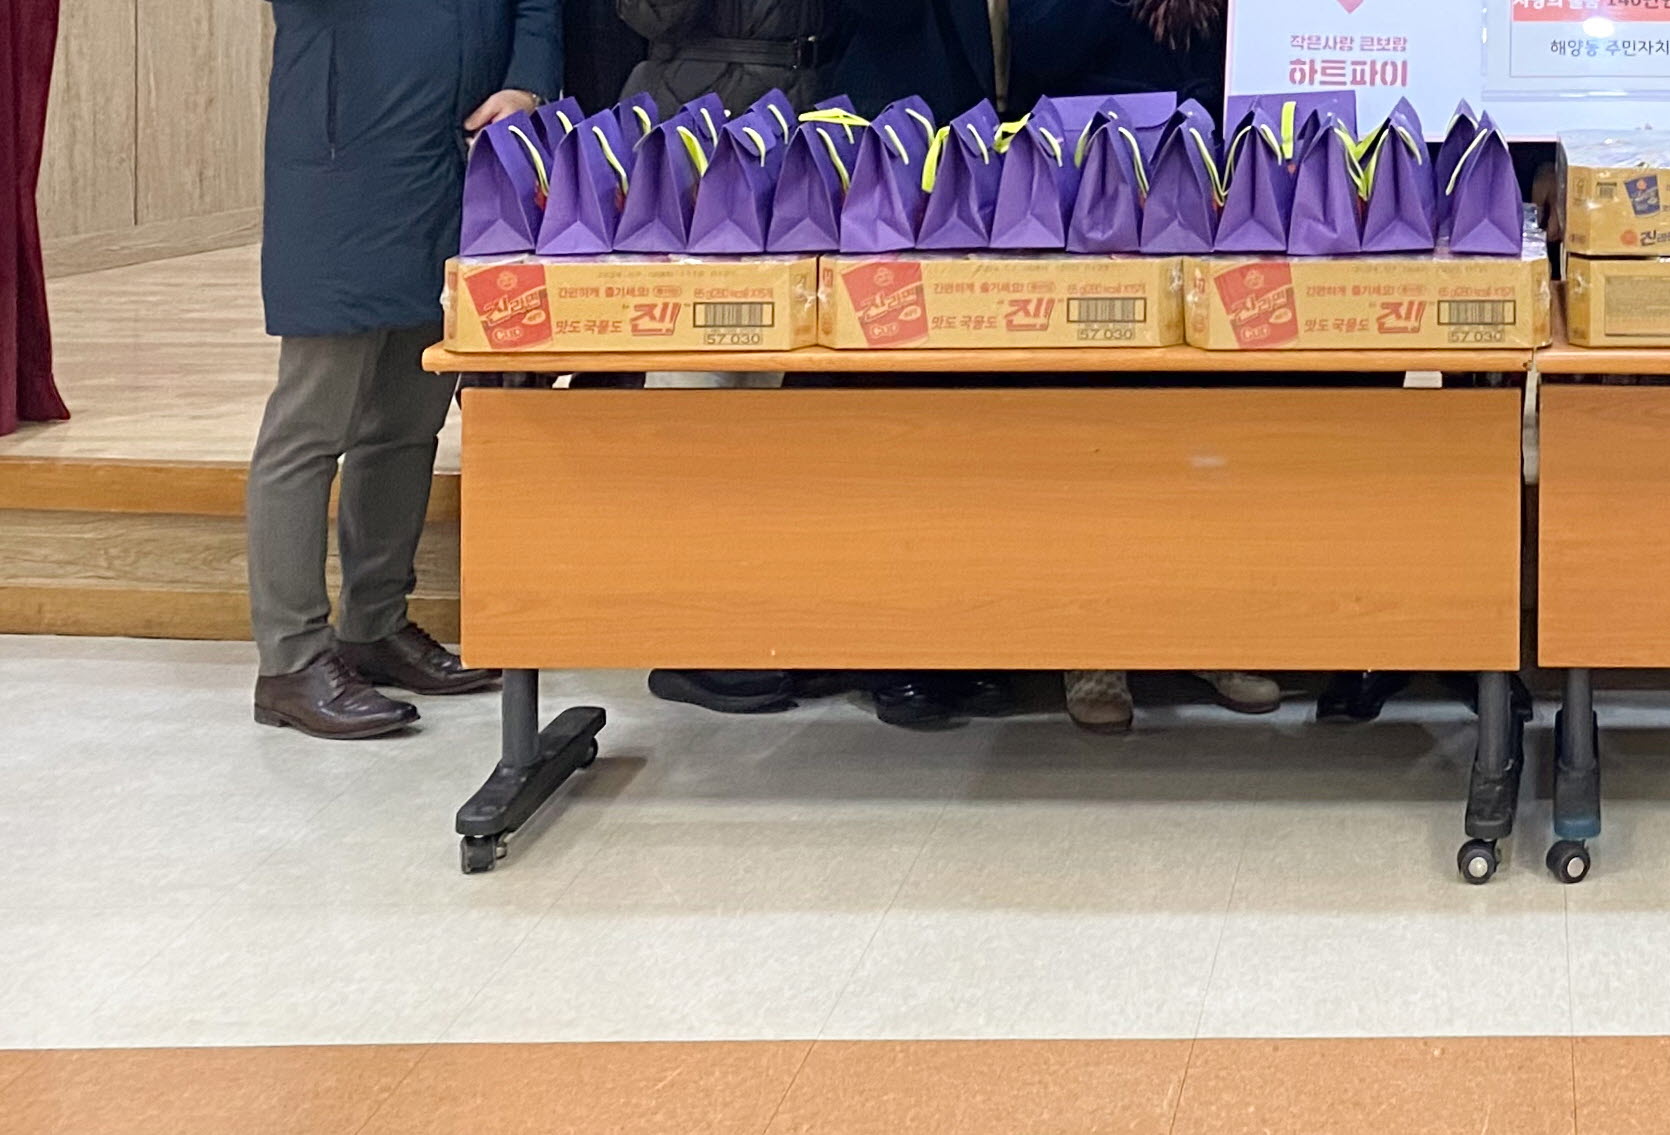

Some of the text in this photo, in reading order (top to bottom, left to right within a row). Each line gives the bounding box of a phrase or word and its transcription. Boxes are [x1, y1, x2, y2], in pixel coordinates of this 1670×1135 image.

[1290, 35, 1354, 51] 작은사랑
[1550, 39, 1599, 57] 해양동
[1288, 58, 1408, 87] 하트파이
[556, 319, 580, 335] 맛도
[1080, 329, 1133, 340] 57 030
[706, 333, 761, 345] 57 030
[1450, 332, 1469, 343] 57
